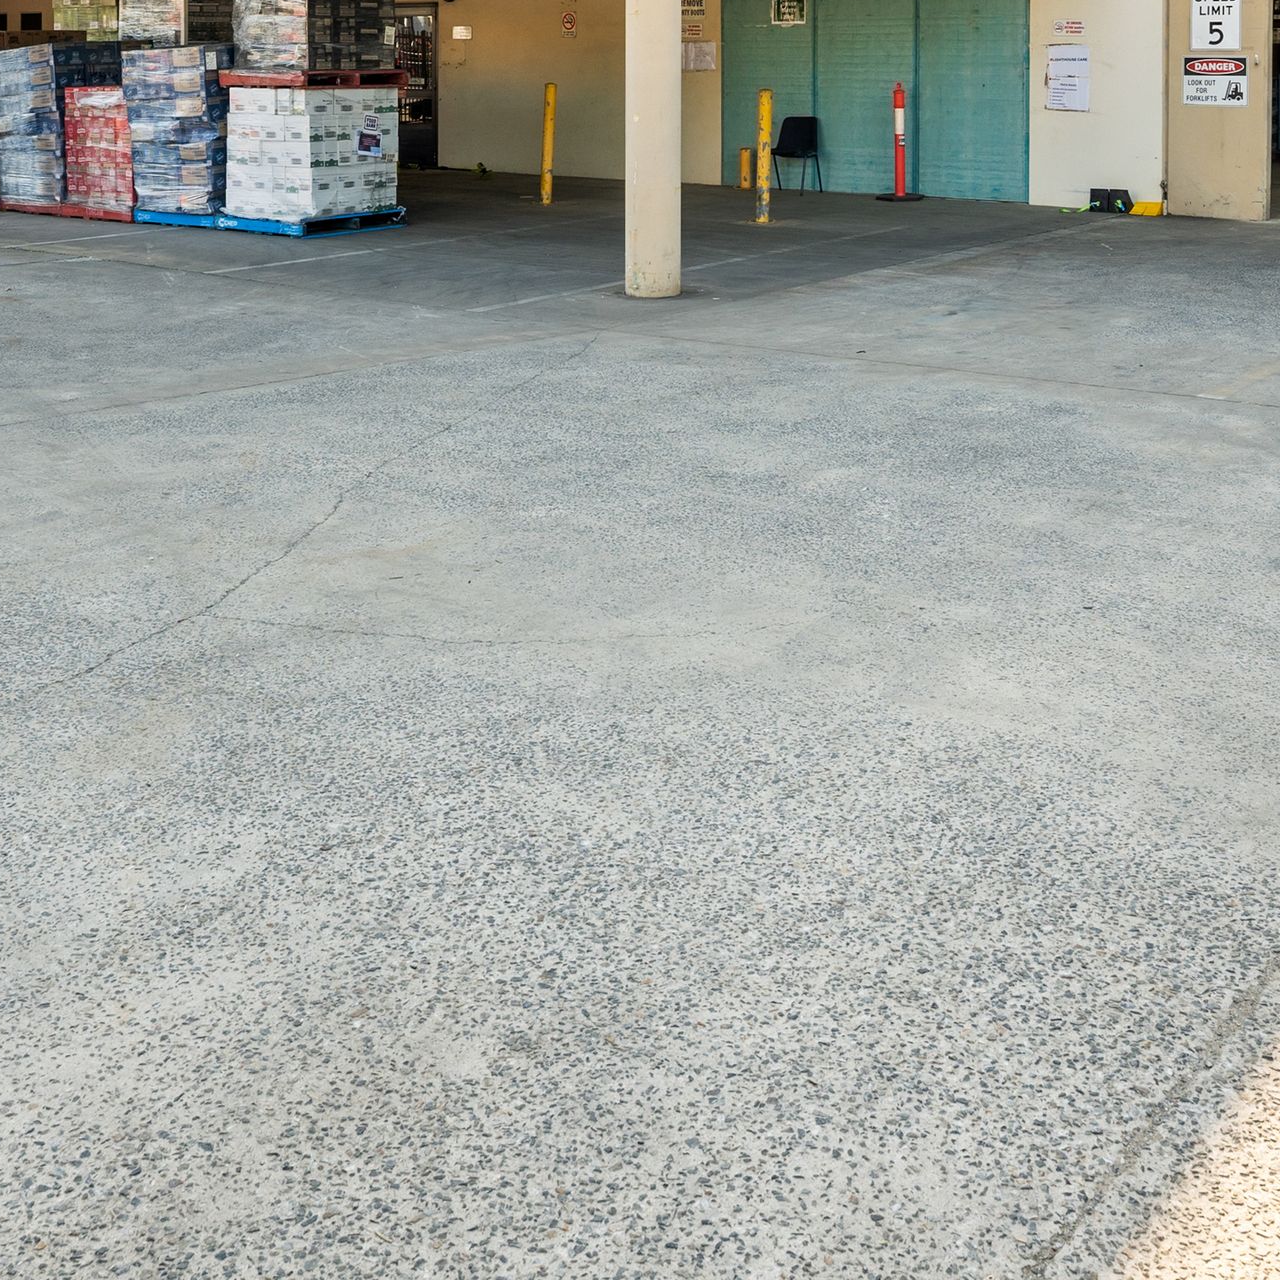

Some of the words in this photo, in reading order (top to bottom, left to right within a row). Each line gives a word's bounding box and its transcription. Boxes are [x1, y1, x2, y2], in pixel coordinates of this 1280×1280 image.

[1199, 5, 1233, 16] LIMIT
[1208, 21, 1224, 45] 5
[1194, 62, 1236, 71] DANGER
